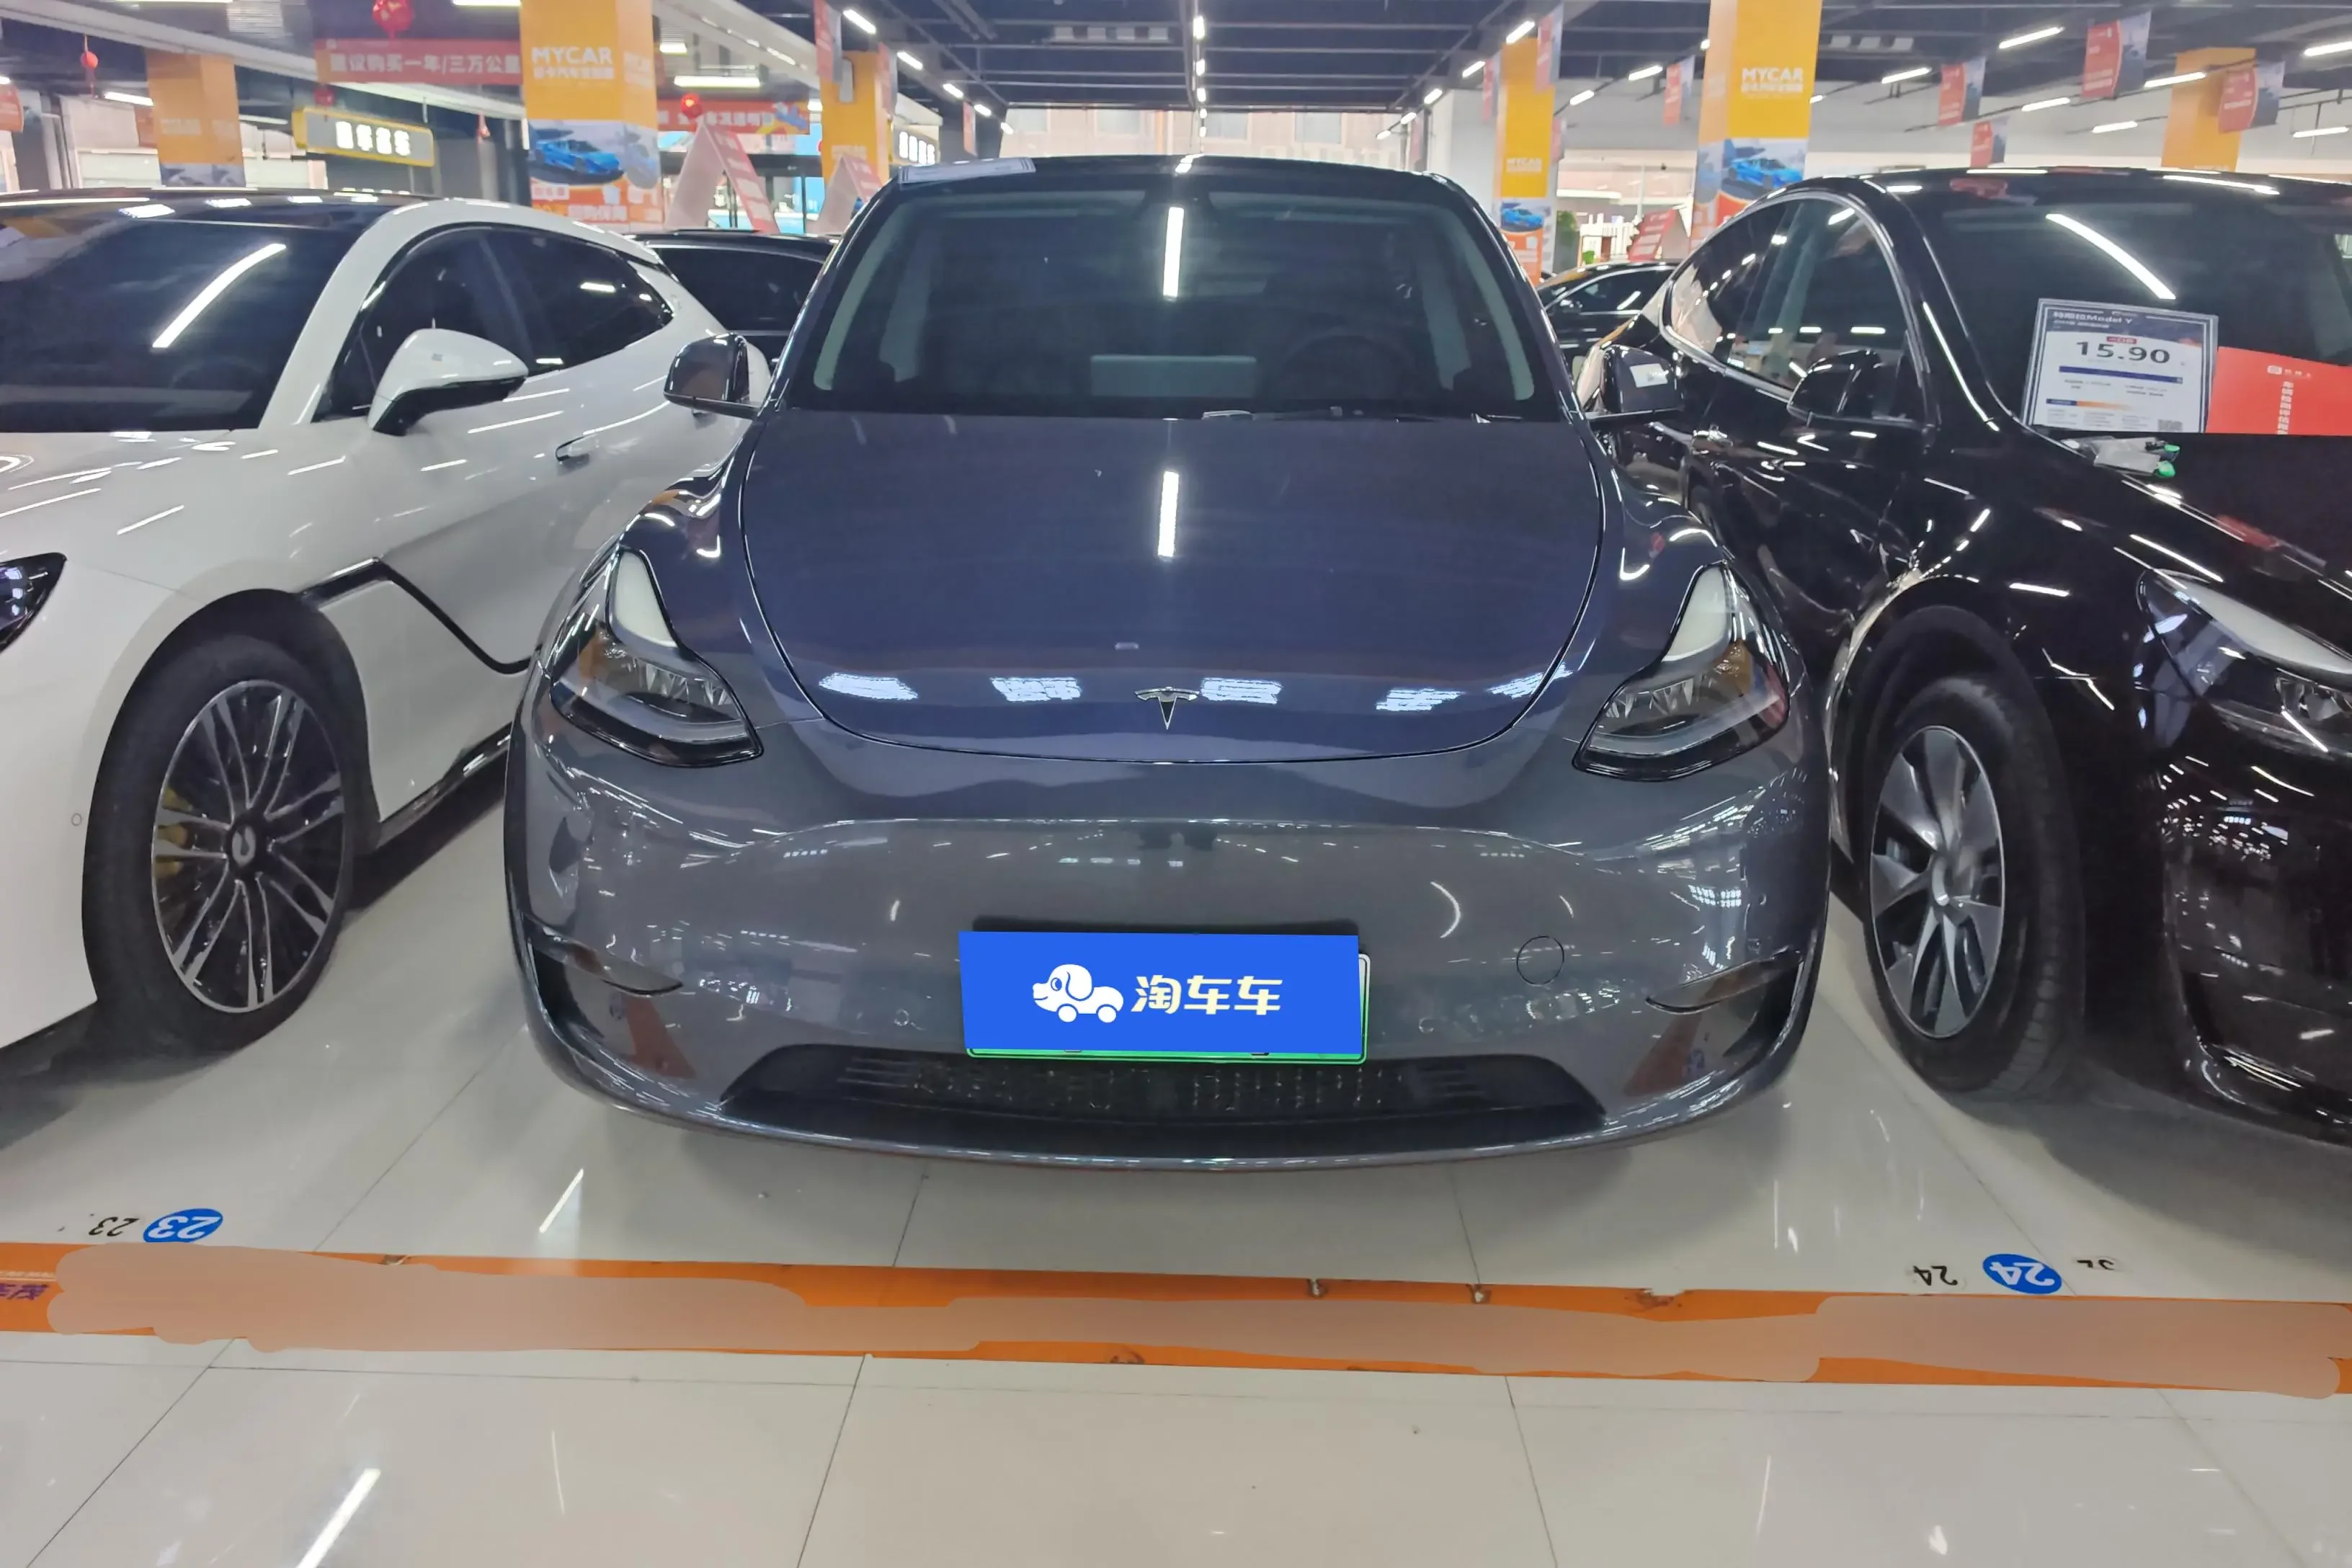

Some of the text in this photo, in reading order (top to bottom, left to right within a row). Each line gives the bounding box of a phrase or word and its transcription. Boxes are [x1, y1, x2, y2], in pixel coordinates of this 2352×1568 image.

[531, 46, 613, 65] MYCAR
[1742, 67, 1803, 81] MYCAR
[2077, 342, 2170, 364] 15.90
[89, 1216, 141, 1237] 23
[148, 1216, 221, 1239] 23
[1912, 1265, 1959, 1286] 24
[1990, 1261, 2055, 1286] 24
